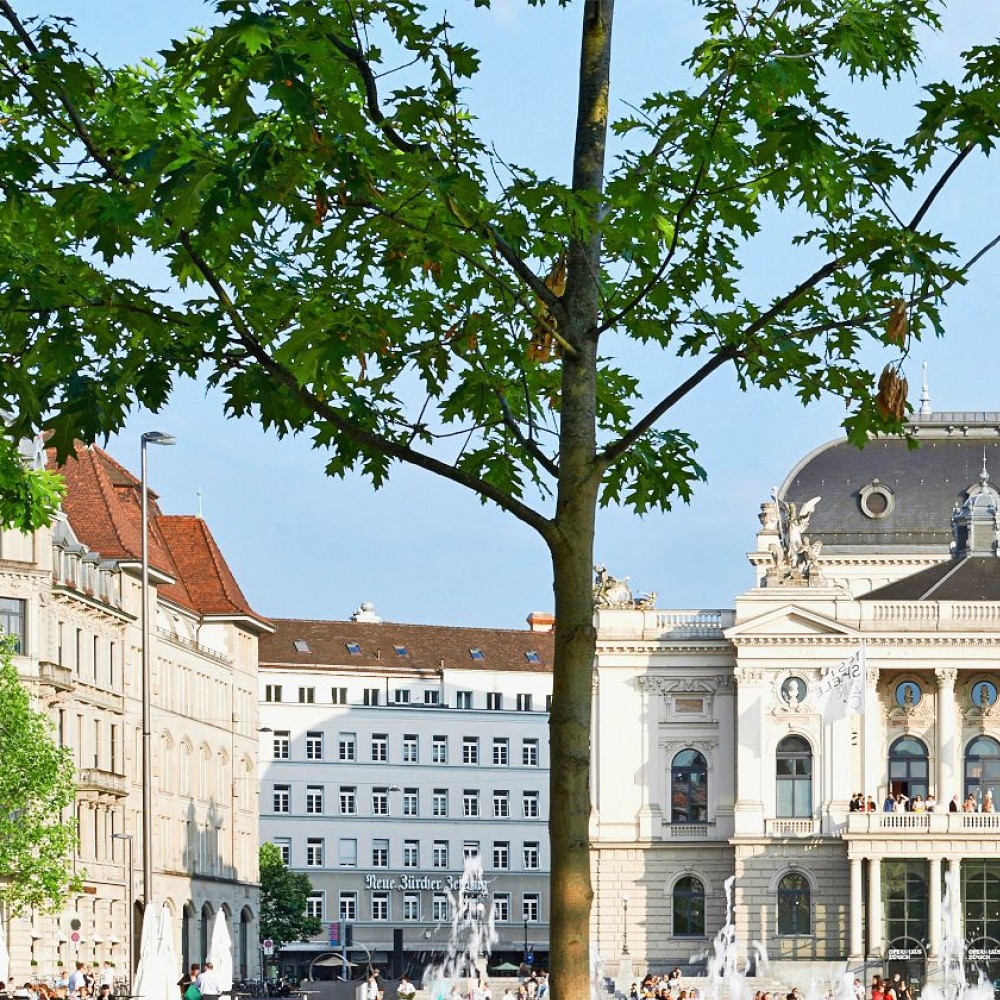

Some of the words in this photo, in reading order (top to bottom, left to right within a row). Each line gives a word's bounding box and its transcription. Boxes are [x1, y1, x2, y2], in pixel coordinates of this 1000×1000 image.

[365, 873, 395, 890] Neue
[399, 874, 442, 891] Zürcher
[443, 875, 488, 895] Zeiung
